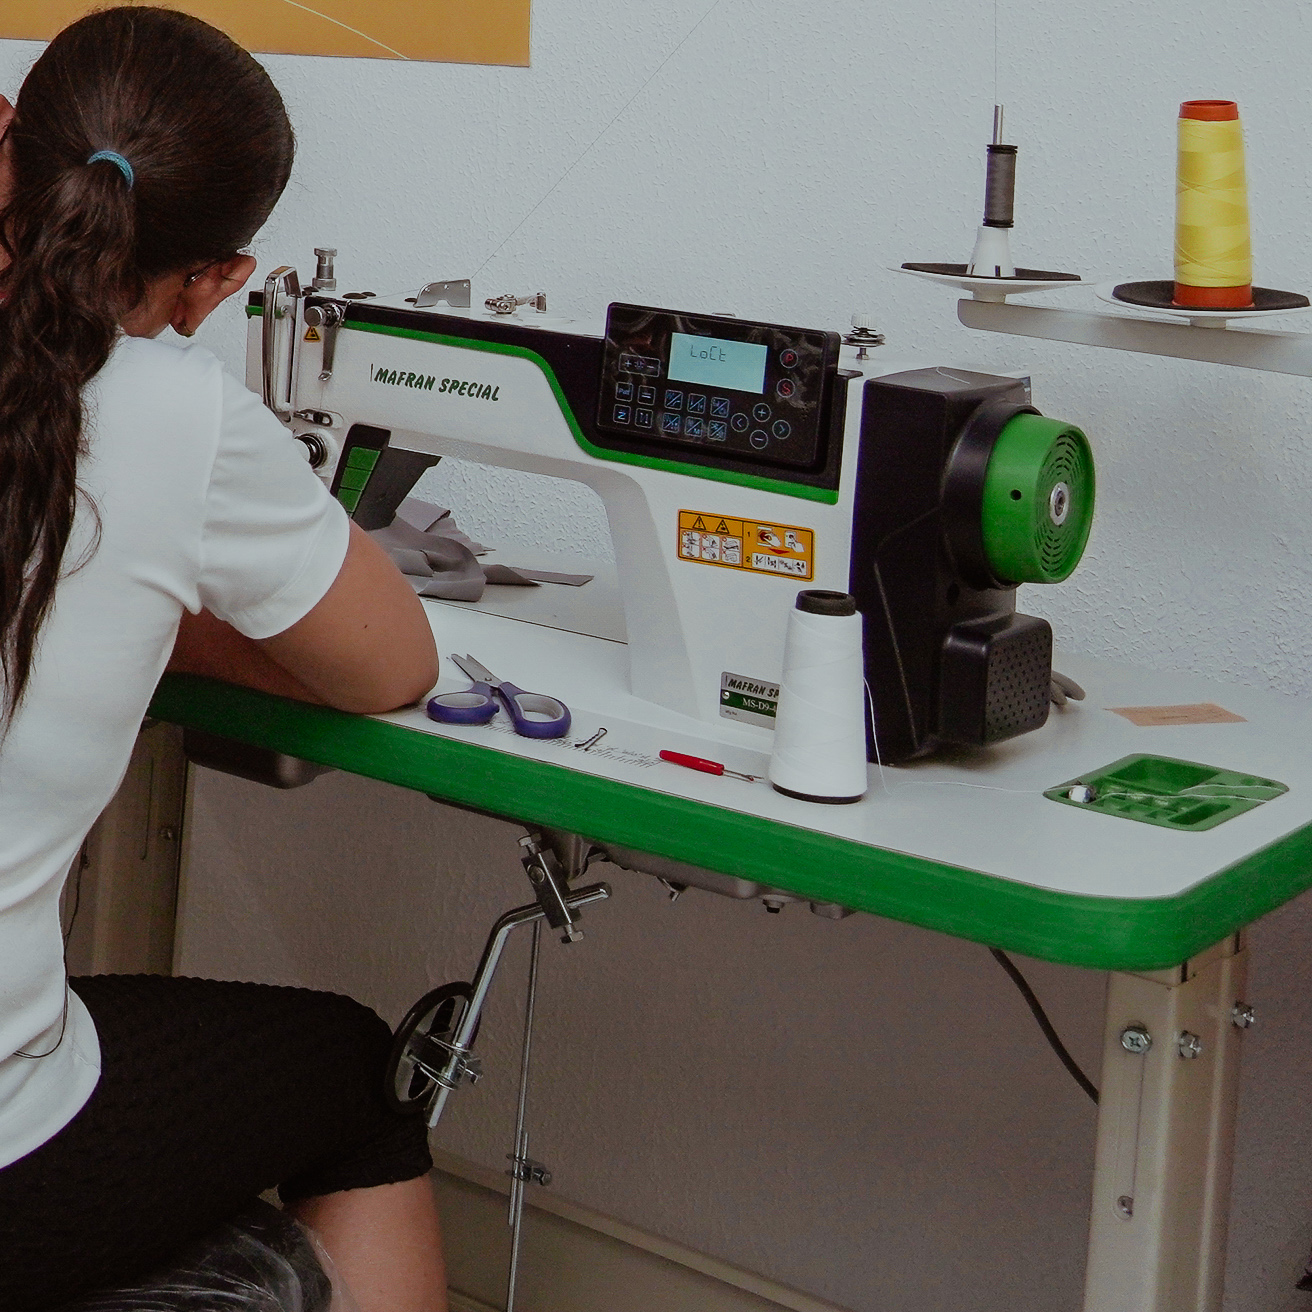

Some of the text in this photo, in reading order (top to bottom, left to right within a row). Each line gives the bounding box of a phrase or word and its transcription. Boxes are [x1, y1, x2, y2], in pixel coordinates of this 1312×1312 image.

[374, 367, 500, 401] MAFRAN SPECIAL
[728, 678, 766, 695] MAFRAN
